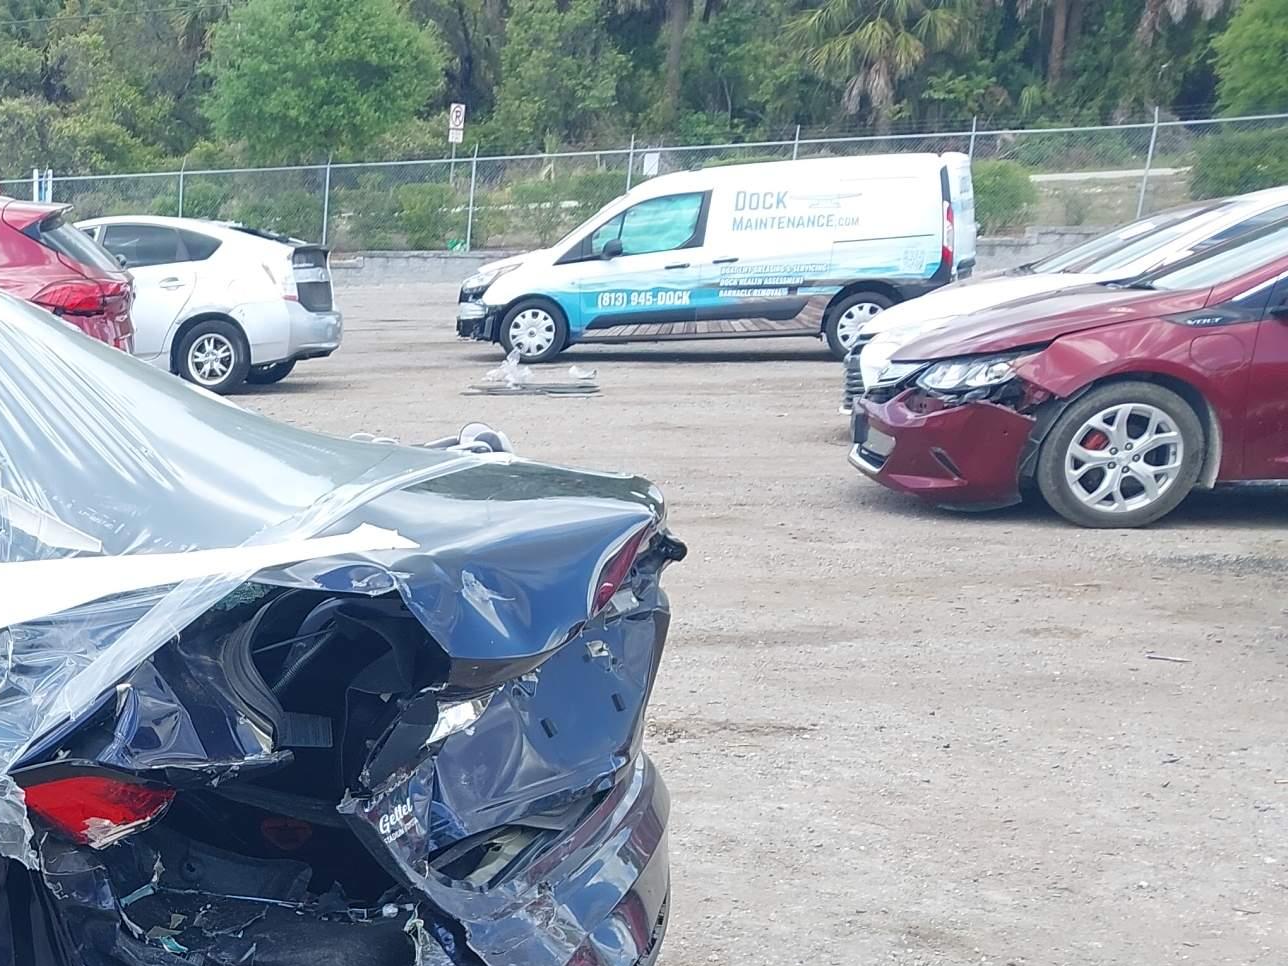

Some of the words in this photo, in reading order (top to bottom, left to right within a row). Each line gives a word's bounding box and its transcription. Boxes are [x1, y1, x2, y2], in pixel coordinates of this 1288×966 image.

[734, 190, 789, 212] DOCK
[793, 263, 829, 273] SERVICING
[719, 277, 738, 287] DOCK
[738, 276, 763, 286] HEALTH
[763, 275, 805, 285] ASSESSMENT
[597, 292, 627, 309] (813)
[630, 291, 691, 305] 945-DOCK
[718, 289, 752, 297] BARNACLE
[379, 797, 414, 835] Gettel
